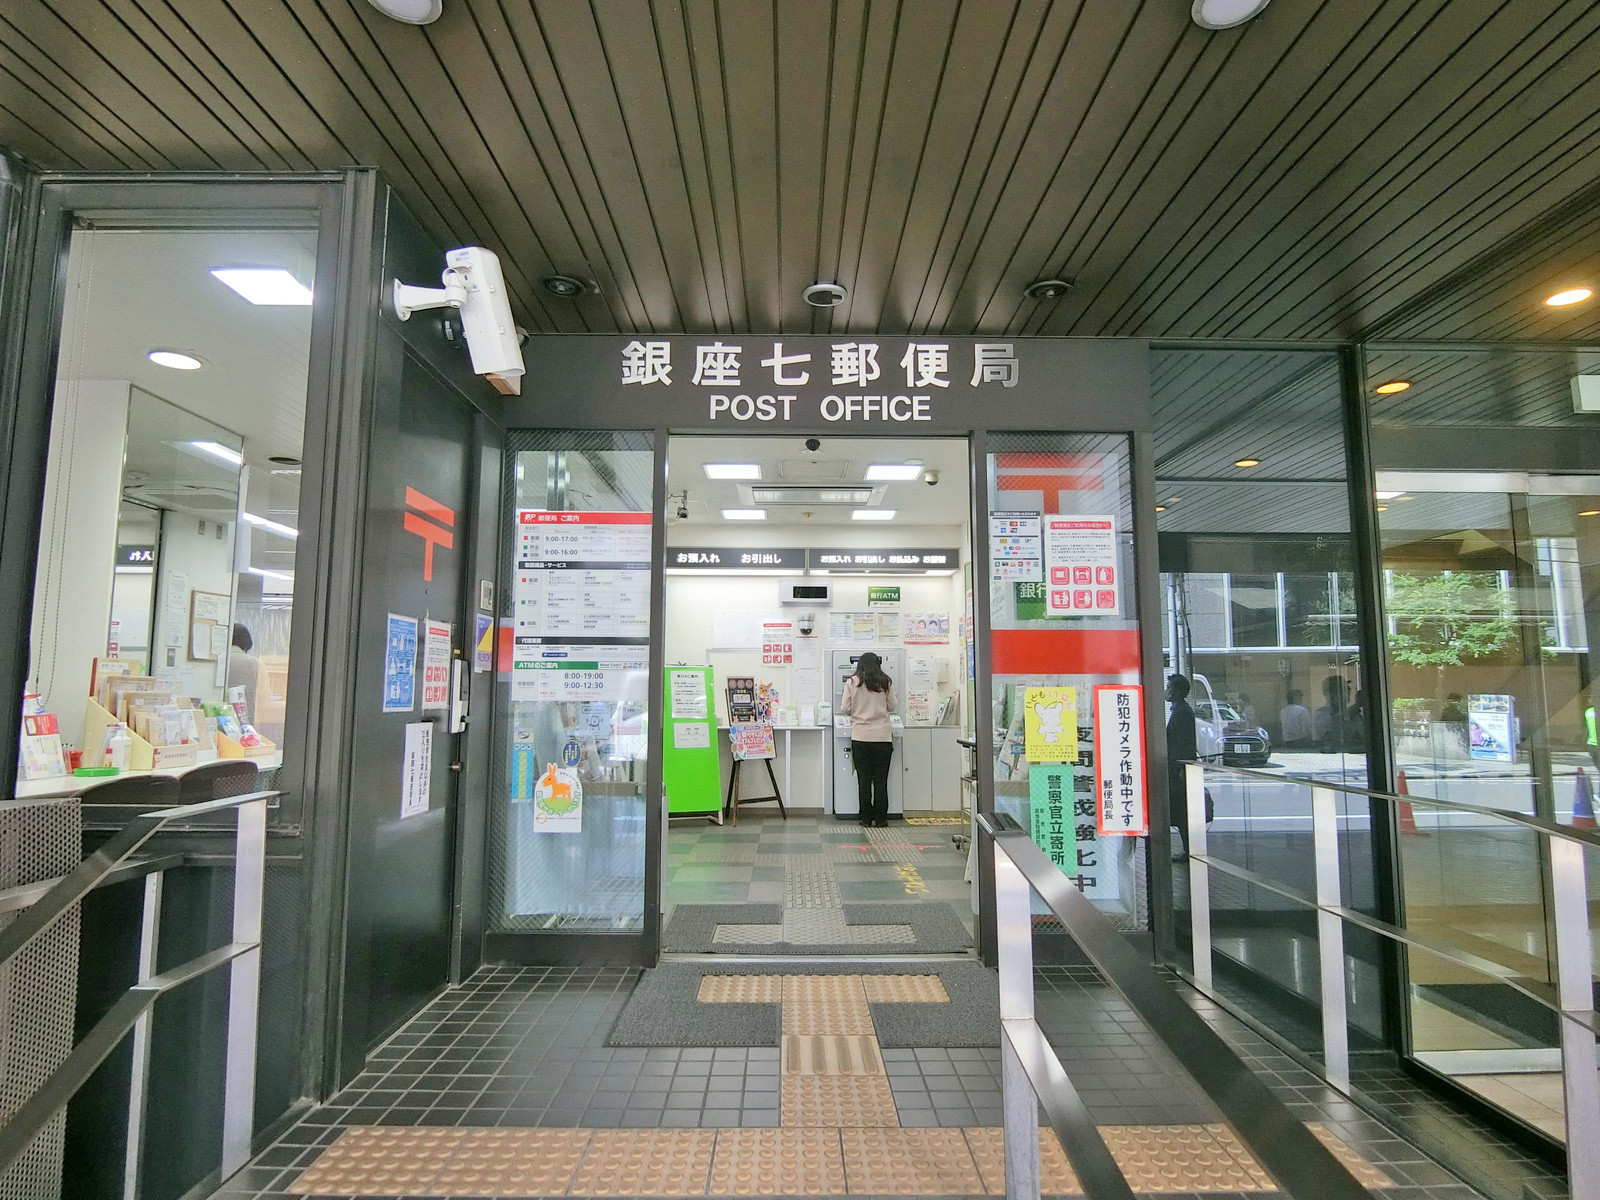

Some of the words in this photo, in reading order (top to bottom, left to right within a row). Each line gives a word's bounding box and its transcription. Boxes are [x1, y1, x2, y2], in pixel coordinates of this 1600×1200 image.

[621, 341, 1019, 388] 銀座七郵便局
[709, 395, 797, 421] POST
[820, 395, 931, 421] OFFICE
[677, 553, 720, 564] お預入れ
[741, 553, 781, 564] お引出し
[820, 555, 852, 564] お預入れ
[855, 555, 885, 564] お引出し
[564, 672, 604, 680] 8:00-19:00
[564, 681, 604, 689] 9:00-12:30
[1117, 693, 1134, 827] 防犯カメラ作動中です
[1103, 780, 1114, 820] 郵便局長
[1047, 775, 1065, 866] 警察官立寄所
